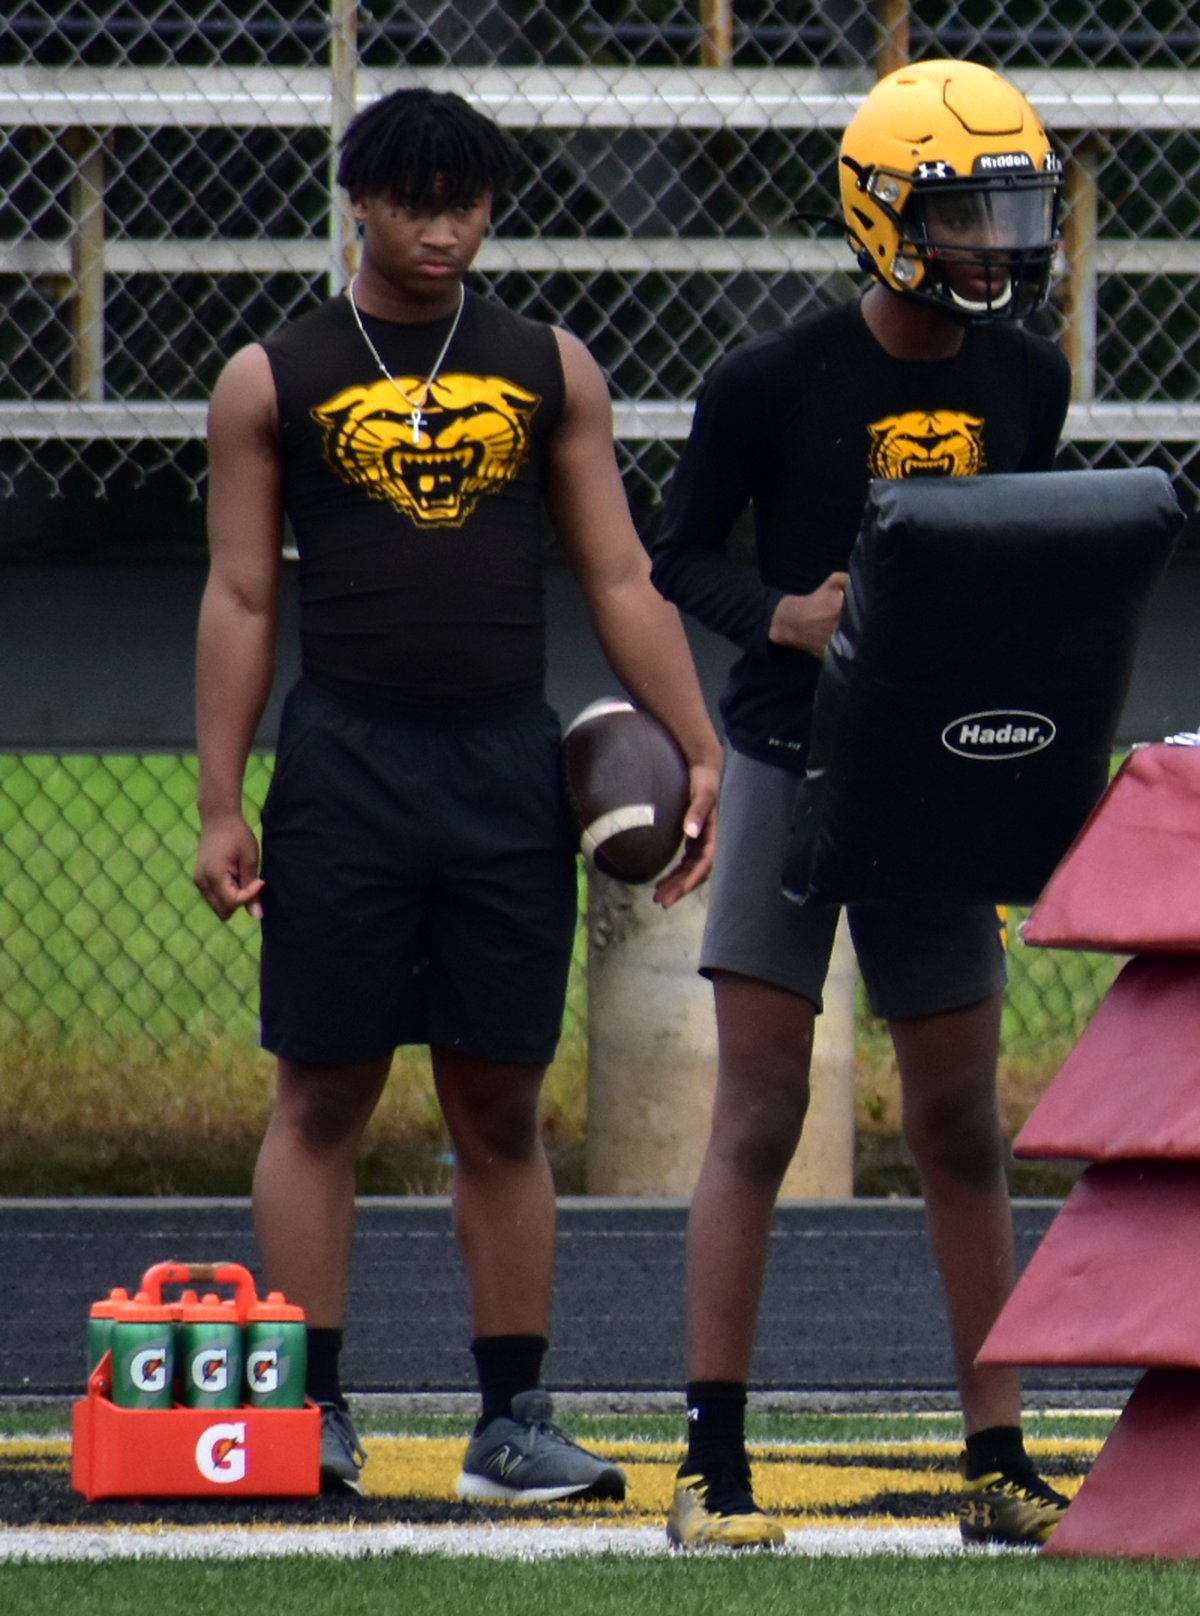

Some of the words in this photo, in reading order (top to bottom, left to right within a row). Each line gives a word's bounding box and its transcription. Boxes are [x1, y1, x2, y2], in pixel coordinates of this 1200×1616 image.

[130, 1348, 166, 1393] G
[191, 1348, 228, 1393] G
[246, 1349, 279, 1394] G
[195, 1421, 248, 1485] G
